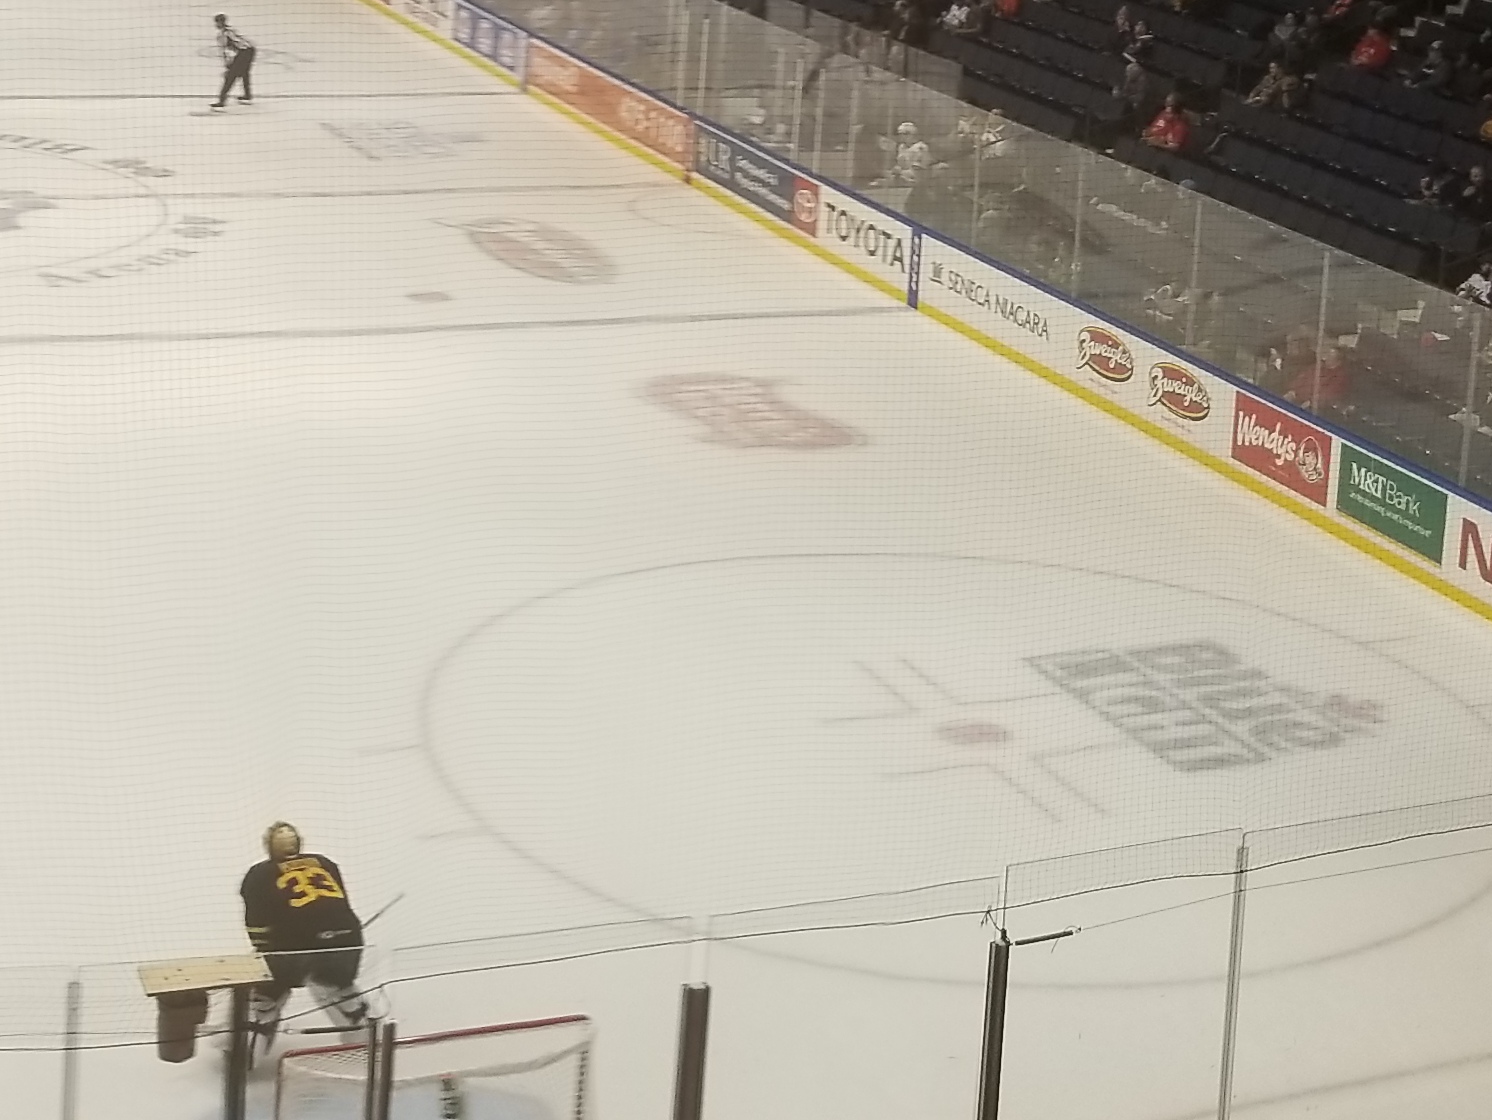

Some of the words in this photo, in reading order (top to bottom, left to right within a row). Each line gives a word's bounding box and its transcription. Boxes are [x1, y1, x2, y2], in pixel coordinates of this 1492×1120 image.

[824, 201, 907, 274] TOYOTA
[947, 270, 991, 309] SENECA
[994, 292, 1050, 341] NIAGARA
[1235, 410, 1297, 465] Wendy's
[1349, 461, 1387, 501] M&T
[1384, 477, 1421, 519] Bank
[275, 866, 347, 908] 33
